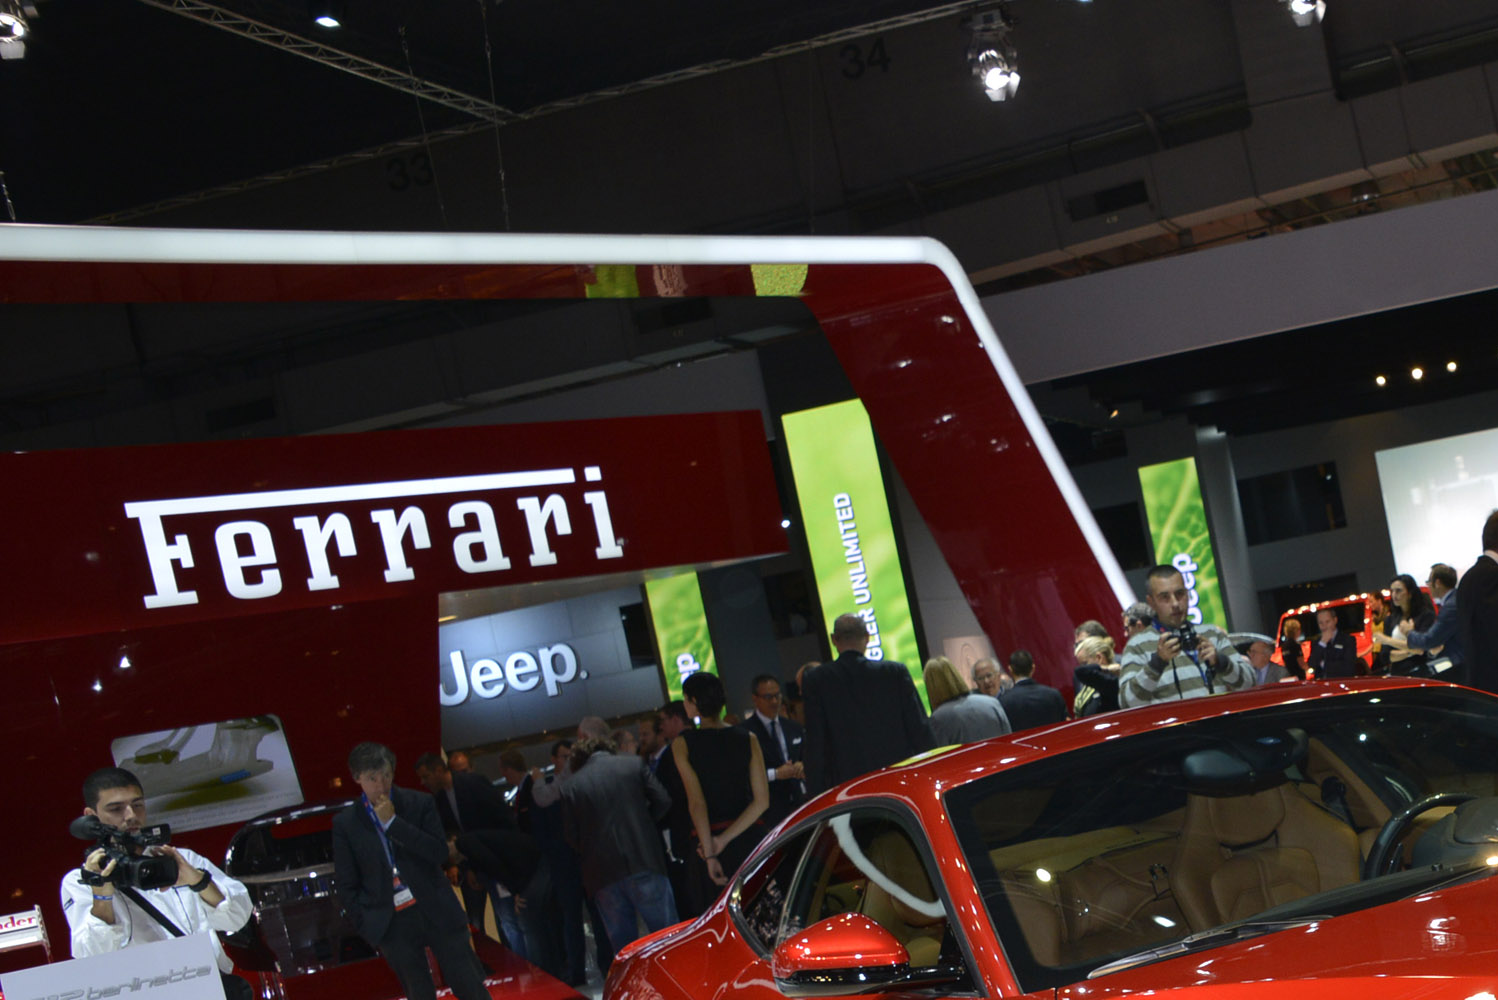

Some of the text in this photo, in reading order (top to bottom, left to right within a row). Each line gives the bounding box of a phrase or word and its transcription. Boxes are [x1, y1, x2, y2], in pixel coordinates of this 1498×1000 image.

[840, 37, 892, 81] 34
[386, 152, 434, 192] 33
[124, 465, 624, 609] Ferrari
[833, 492, 872, 605] UNLIMITED
